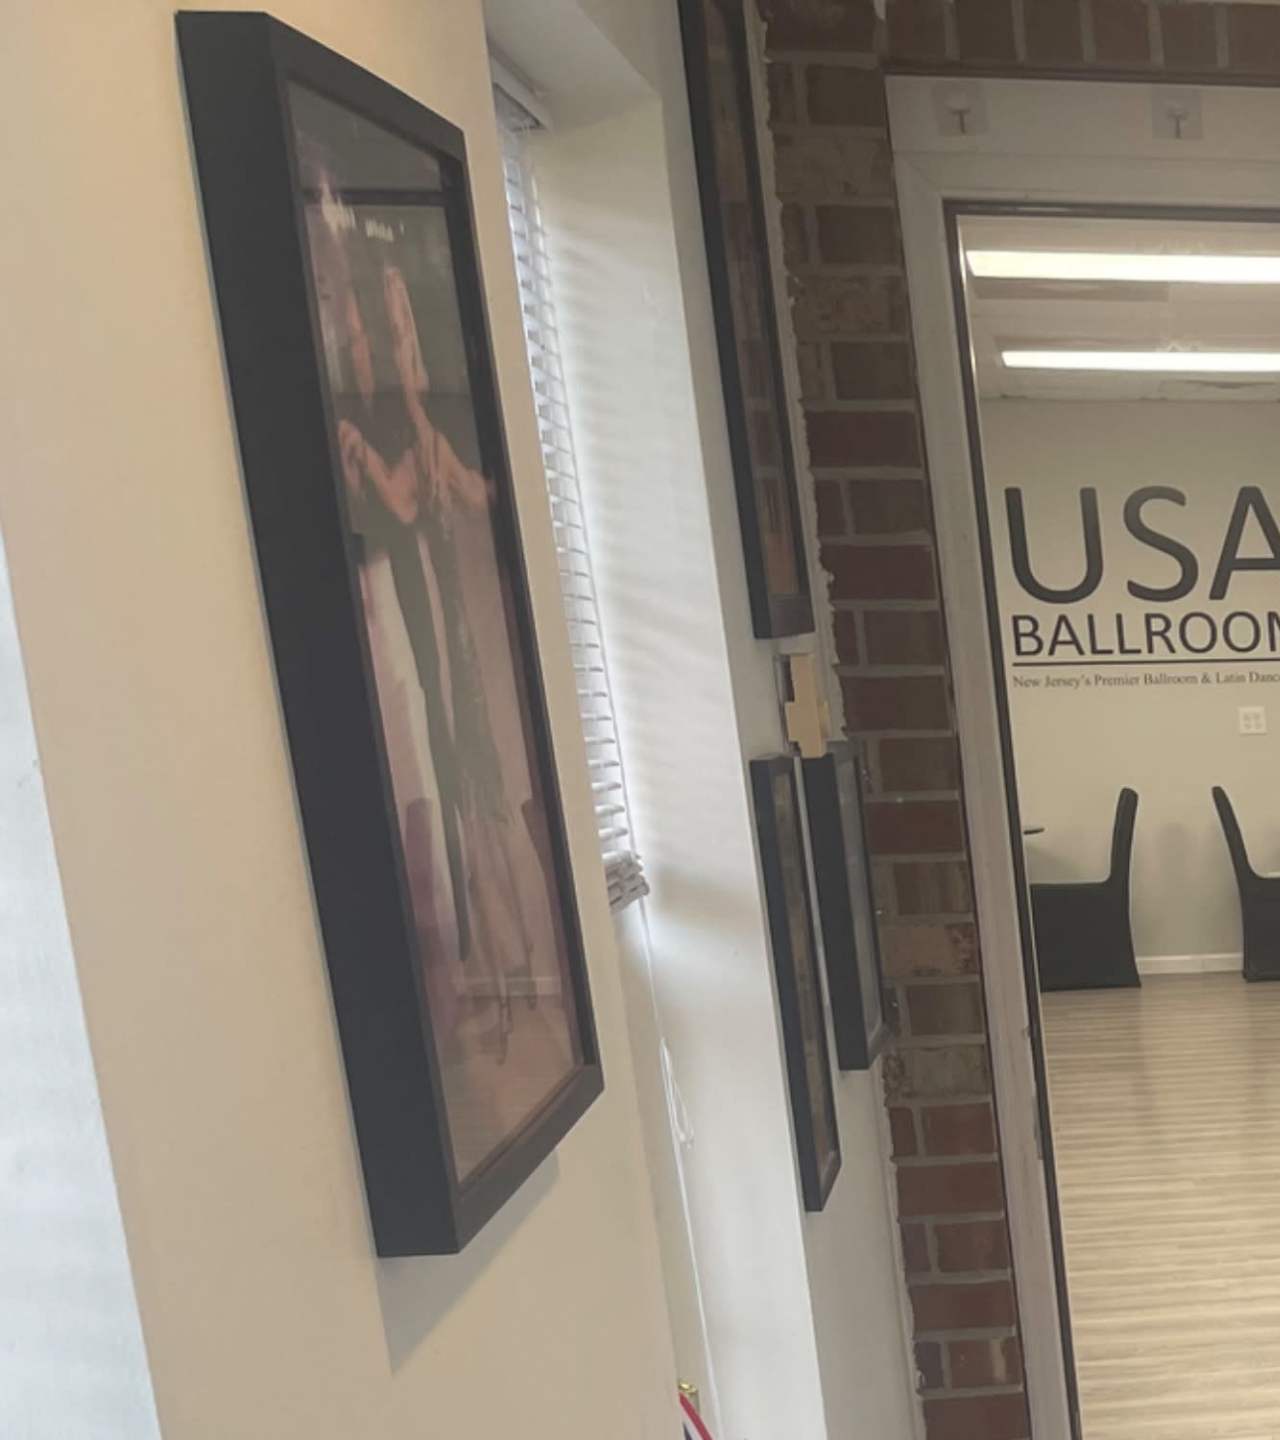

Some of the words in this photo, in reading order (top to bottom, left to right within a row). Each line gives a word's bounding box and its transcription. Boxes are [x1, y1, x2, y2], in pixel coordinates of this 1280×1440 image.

[1012, 674, 1040, 688] New
[1044, 673, 1092, 690] Jersey's
[1094, 672, 1140, 687] Premier
[1143, 672, 1198, 686] Ballroom
[1200, 671, 1212, 685] &
[1216, 670, 1247, 685] Latin
